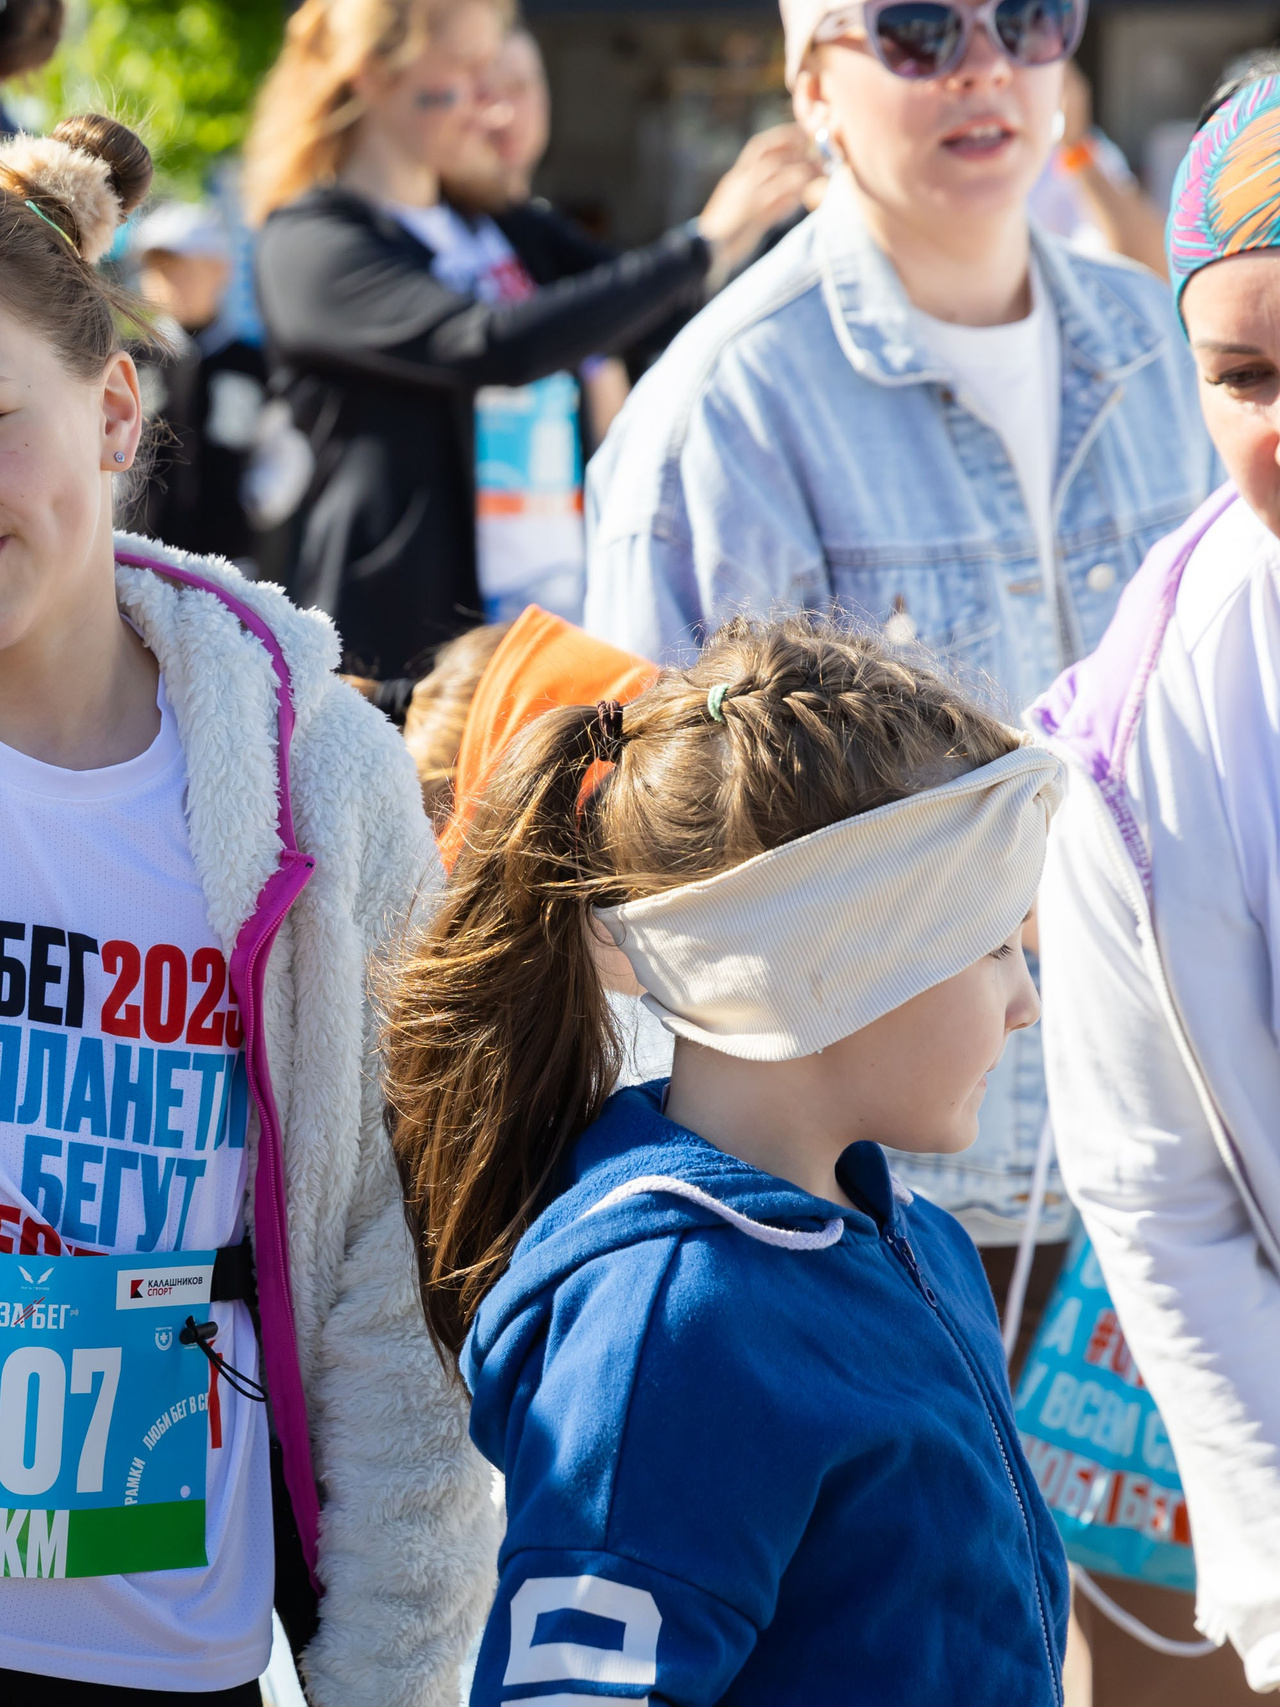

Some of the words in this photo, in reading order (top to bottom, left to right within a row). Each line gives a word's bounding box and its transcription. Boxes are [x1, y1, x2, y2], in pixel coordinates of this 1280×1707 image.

[21, 1134, 205, 1252] БЕГУТ
[147, 1287, 173, 1297] СПОРТ
[148, 1276, 203, 1288] КАЛАШНИКОВ
[124, 1457, 146, 1506] РАМКИ
[142, 1412, 172, 1451] ЛЮБИ
[170, 1399, 187, 1424] БЕГ
